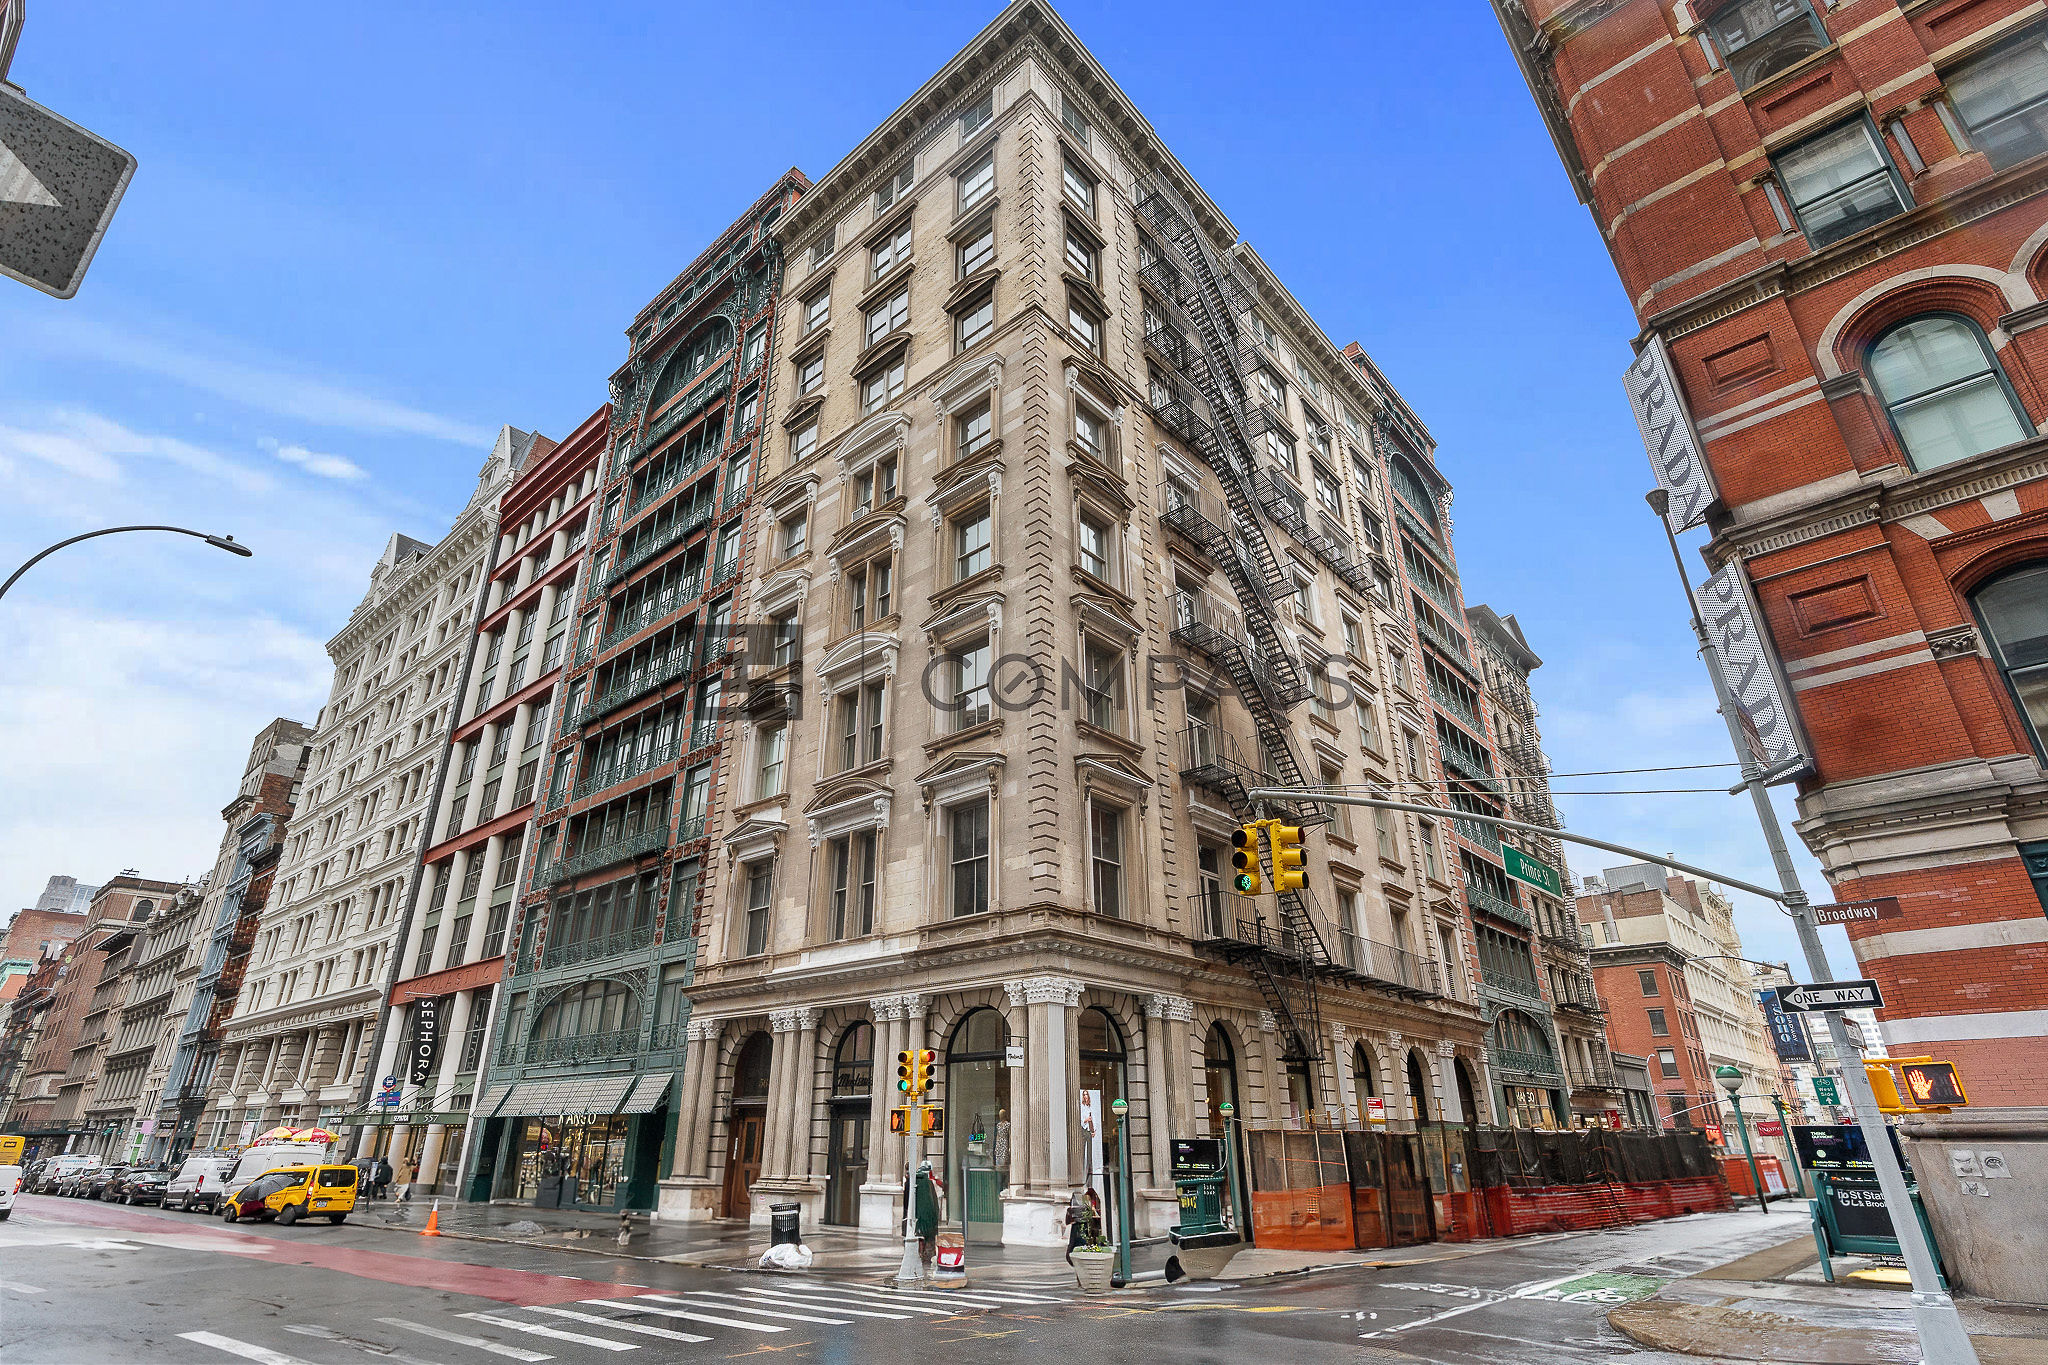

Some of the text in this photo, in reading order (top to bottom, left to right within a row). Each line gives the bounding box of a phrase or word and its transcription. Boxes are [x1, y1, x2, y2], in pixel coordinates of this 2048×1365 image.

[1630, 351, 1702, 525] PRADA
[1519, 858, 1542, 883] Prince
[1817, 905, 1878, 923] Broadway
[1793, 989, 1864, 1004] ONE WAY
[413, 1001, 434, 1081] SEPHORA
